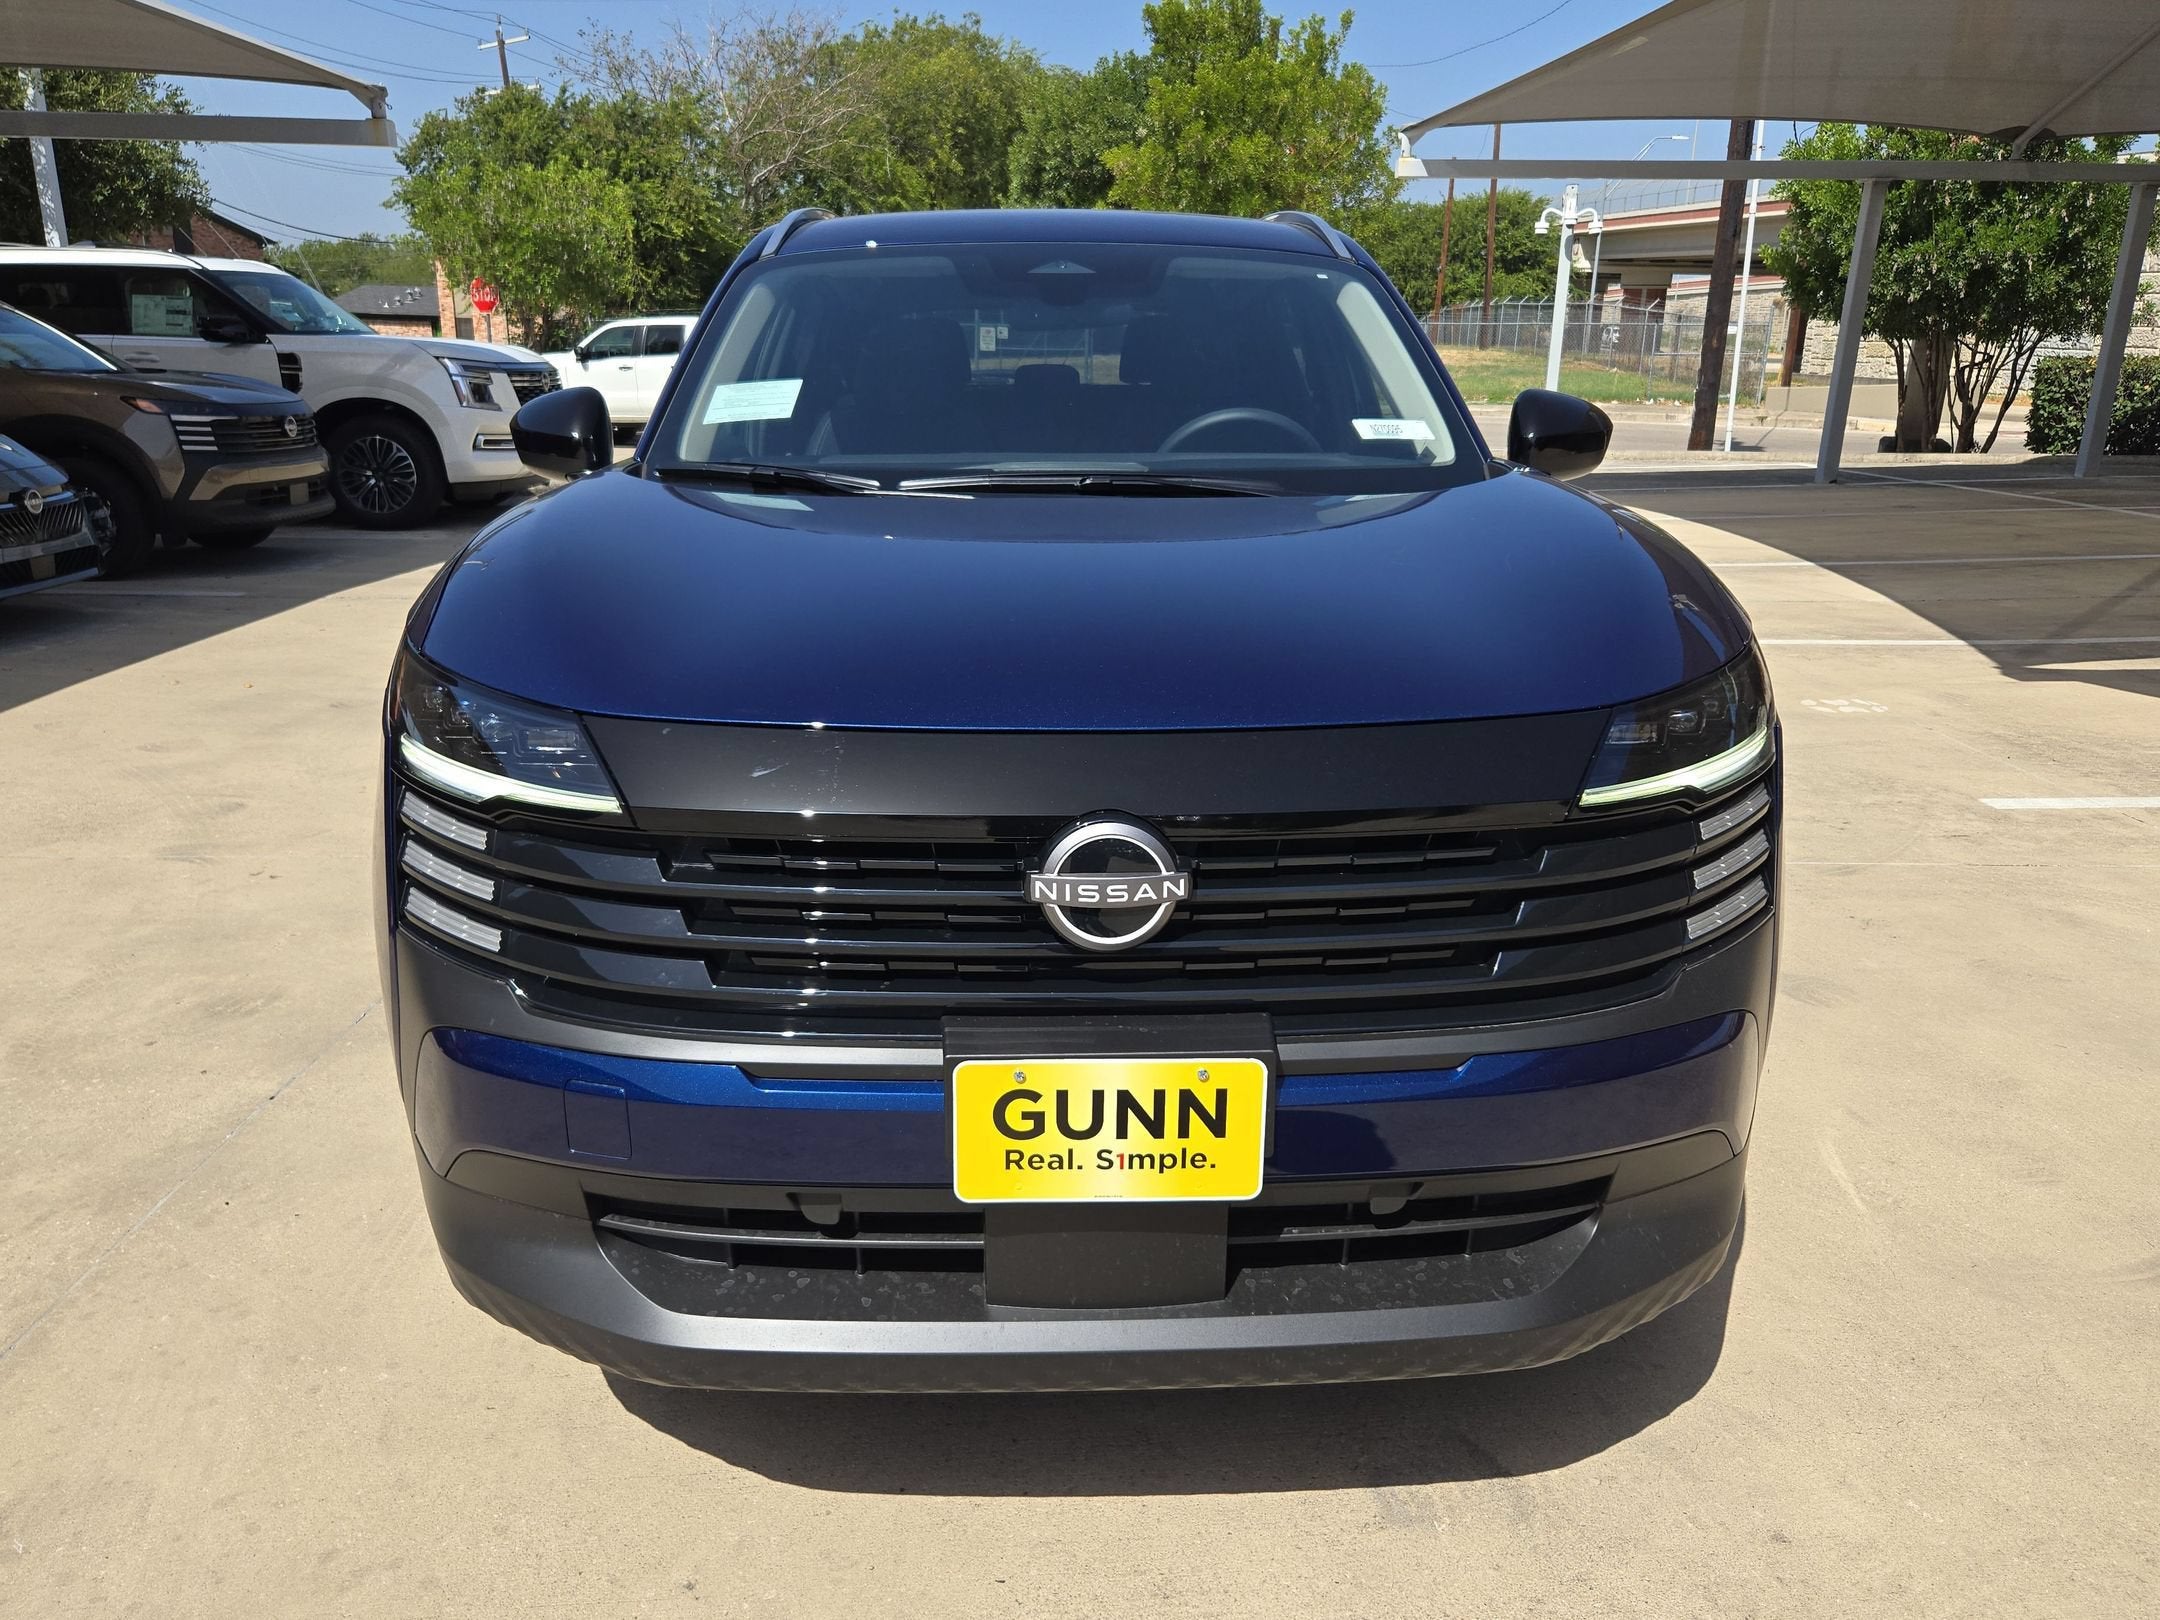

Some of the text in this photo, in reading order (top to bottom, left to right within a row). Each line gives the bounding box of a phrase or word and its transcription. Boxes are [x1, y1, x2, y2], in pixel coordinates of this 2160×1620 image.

[1034, 878, 1185, 903] NISSAN
[993, 1088, 1228, 1141] GUNN
[1005, 1148, 1083, 1170] Real.
